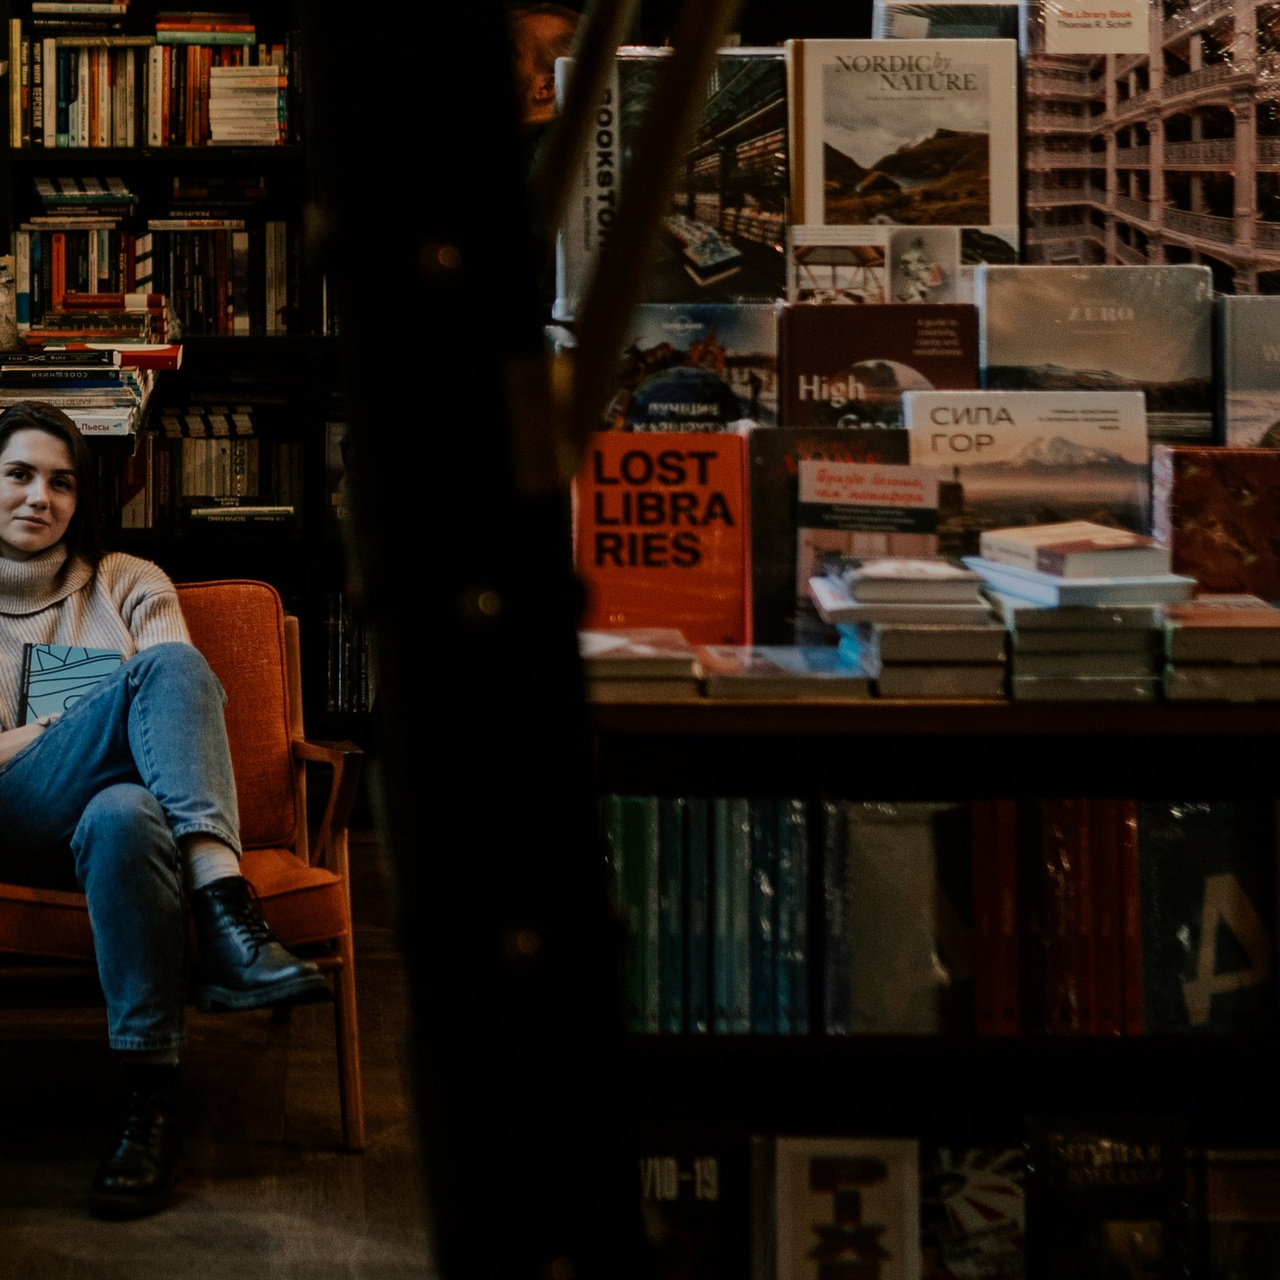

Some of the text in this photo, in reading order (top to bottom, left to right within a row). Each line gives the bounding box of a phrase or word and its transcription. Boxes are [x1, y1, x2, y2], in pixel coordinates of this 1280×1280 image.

[1058, 20, 1092, 29] Thomas
[1076, 9, 1107, 21] Library
[1109, 9, 1132, 19] Book
[835, 51, 952, 73] NORDIC by
[880, 73, 978, 91] NATURE
[32, 86, 42, 128] ПЕРСОНАЖ
[30, 371, 88, 379] СООБЩНИКИ
[797, 374, 867, 409] High
[929, 406, 1015, 426] СИЛА
[81, 423, 110, 433] Пьесы
[930, 433, 995, 453] ГОР
[593, 449, 719, 486] LOST
[593, 490, 735, 528] LIBRA
[593, 531, 702, 568] RIES
